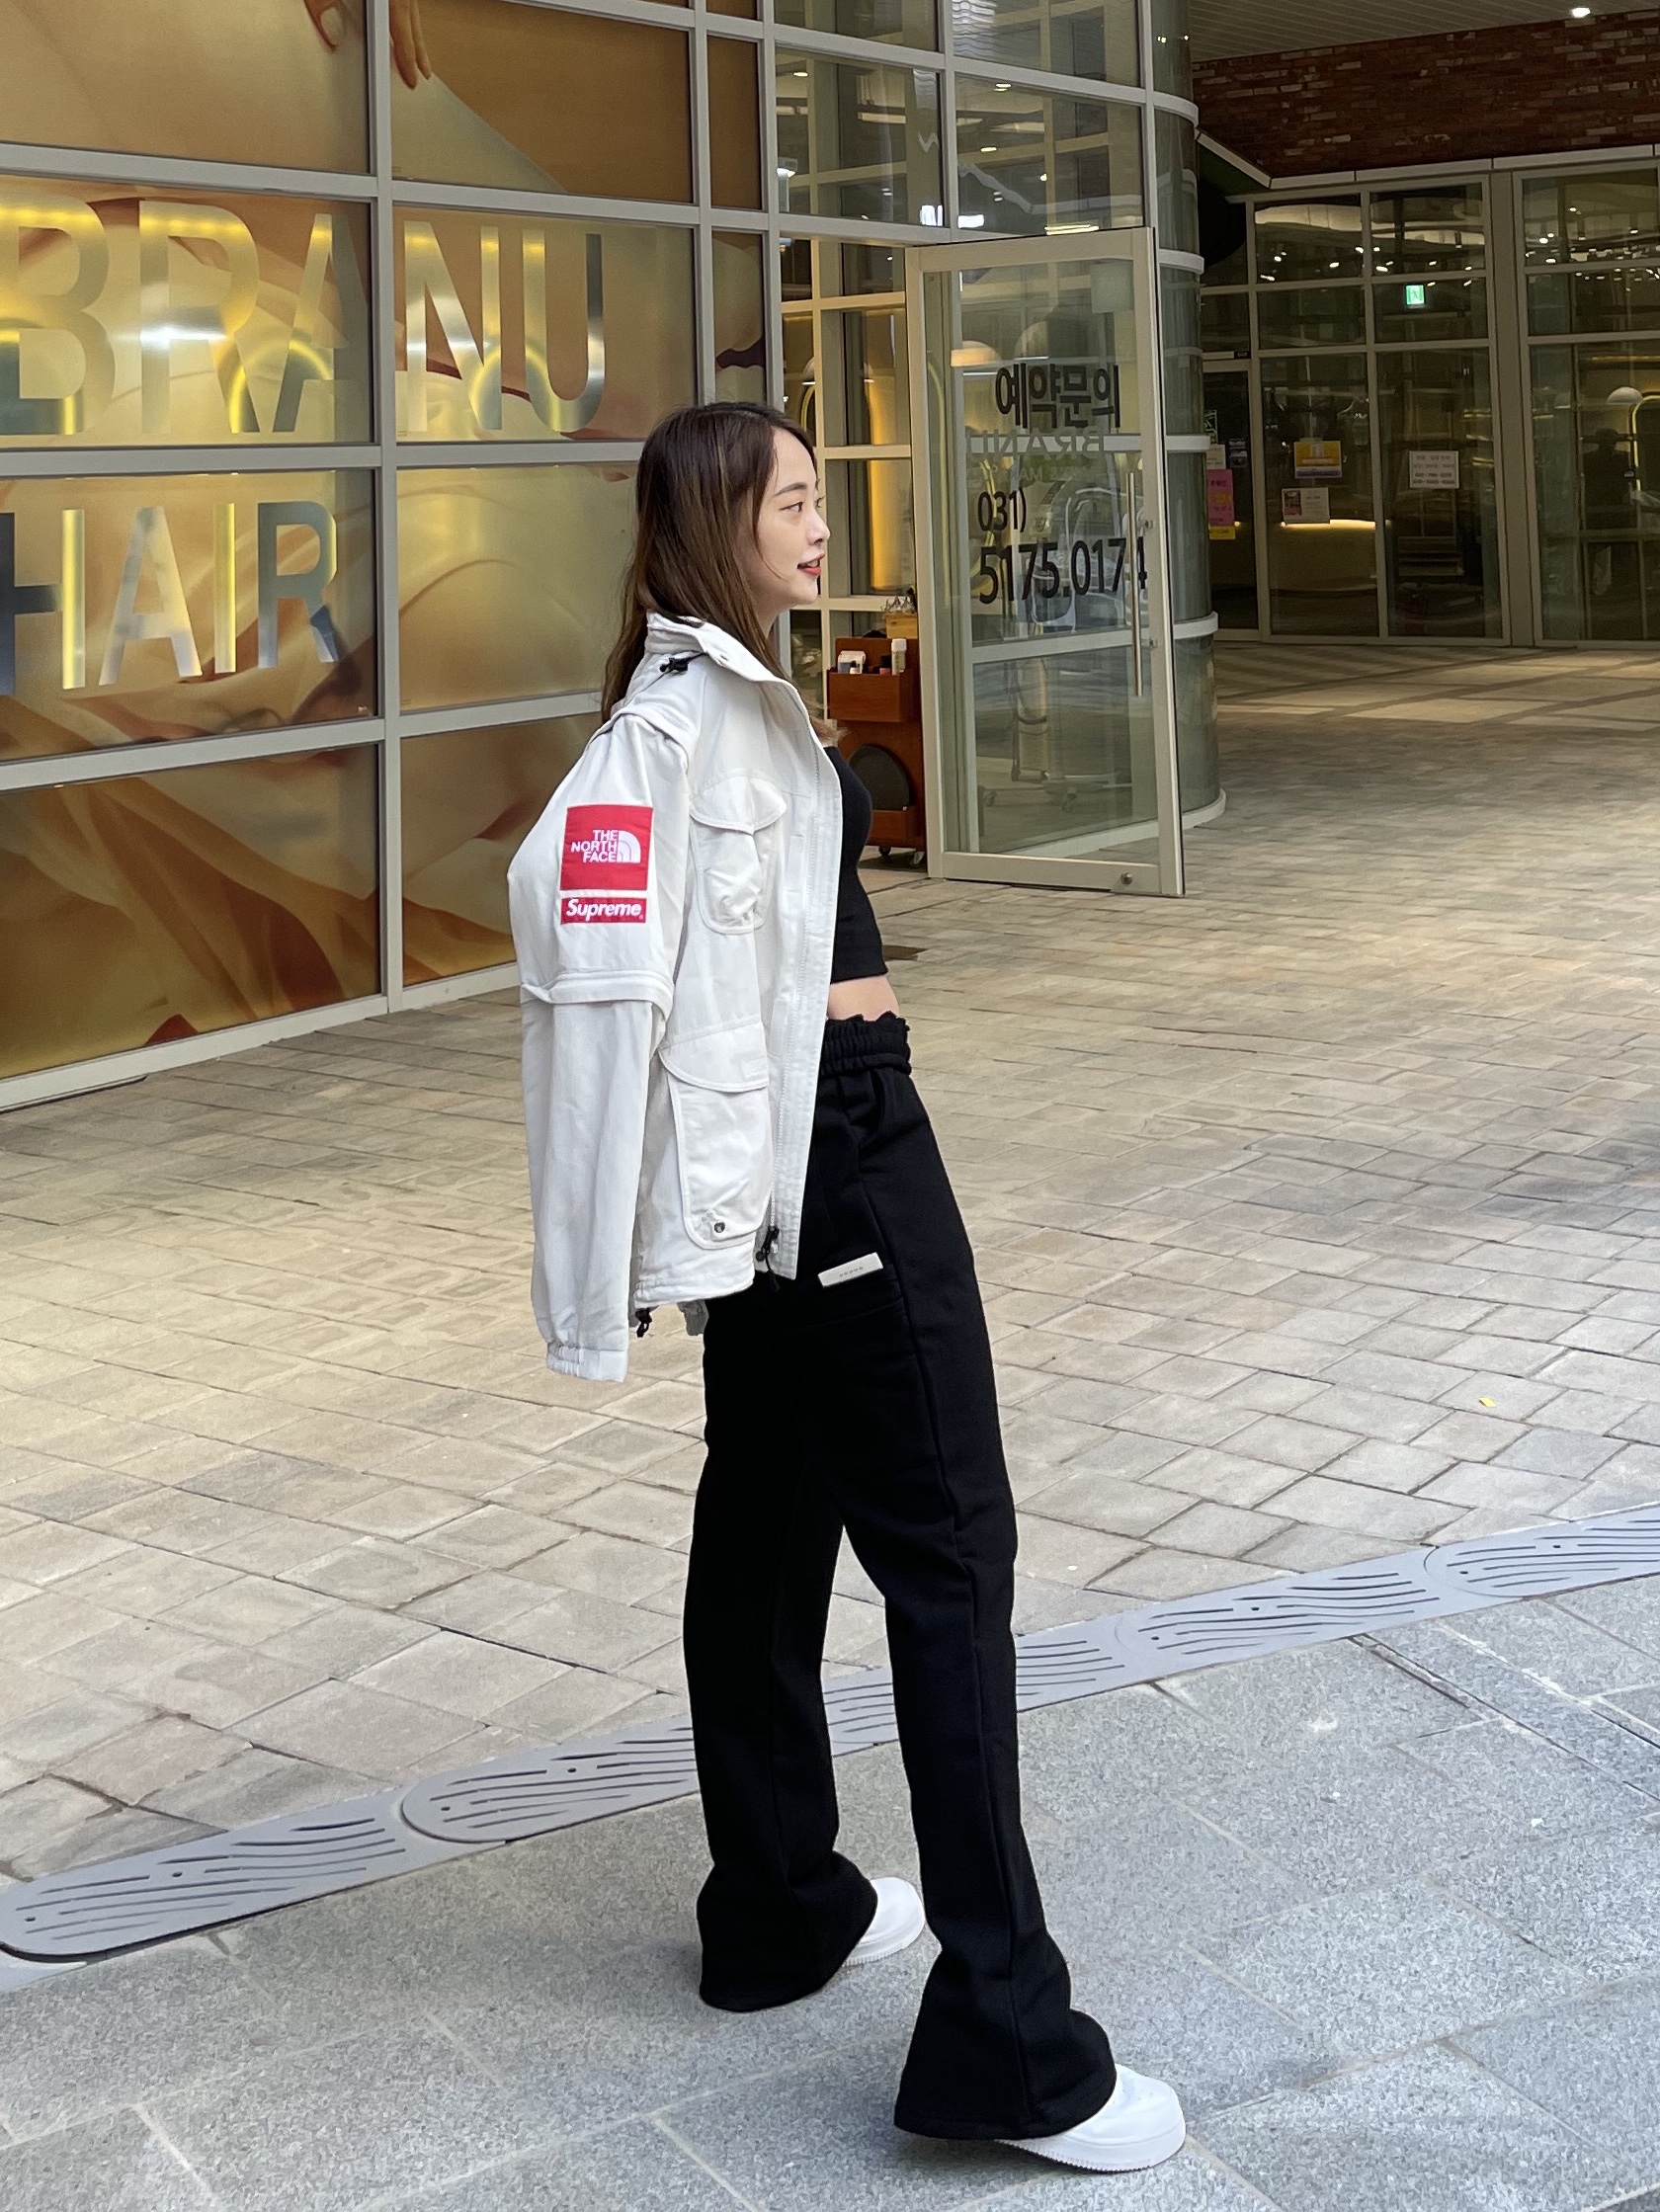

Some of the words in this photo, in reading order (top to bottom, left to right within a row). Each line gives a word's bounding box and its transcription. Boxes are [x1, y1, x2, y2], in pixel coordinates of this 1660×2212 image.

[0, 194, 606, 435] BRANU
[995, 362, 1120, 429] 예약문의
[977, 487, 1027, 533] 031)
[0, 500, 340, 696] HAIR
[570, 841, 619, 853] NORTH
[592, 829, 619, 841] THE
[582, 852, 618, 863] FACE
[565, 897, 642, 922] Supreme
